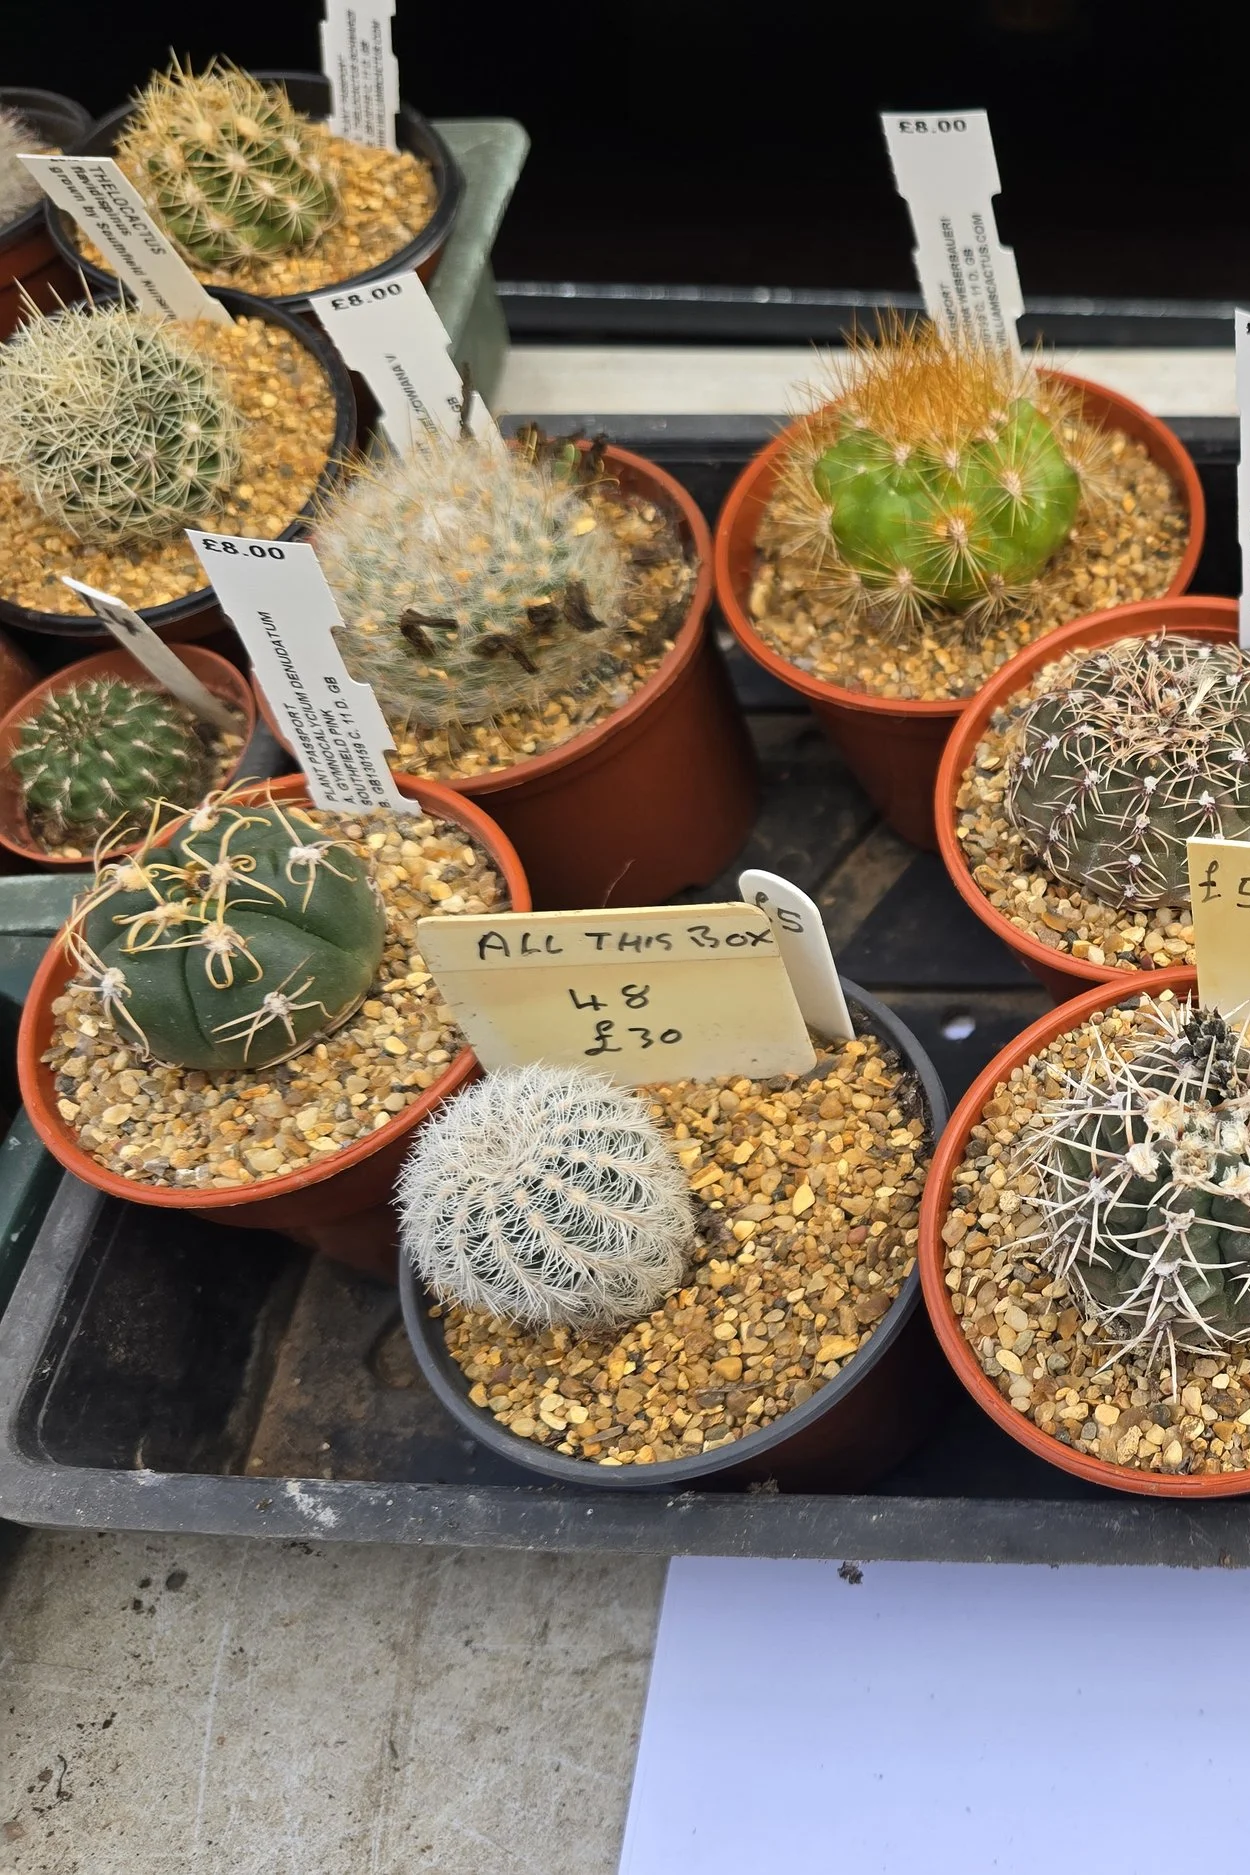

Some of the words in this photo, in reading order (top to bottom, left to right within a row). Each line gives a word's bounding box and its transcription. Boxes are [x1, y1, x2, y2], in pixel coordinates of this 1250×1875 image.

[899, 120, 966, 133] £8.00
[71, 166, 132, 237] flavidispinus
[89, 166, 166, 256] THELOCACTUS
[49, 167, 85, 202] grown
[83, 205, 99, 220] by
[97, 222, 147, 277] Southfield
[331, 283, 403, 311] £8.00
[202, 538, 285, 560] £8.00
[258, 611, 304, 690] DENUDATUM
[324, 676, 341, 694] GB
[335, 698, 350, 710] D.
[283, 702, 320, 765] PASSPORT
[320, 709, 341, 736] PINK
[343, 713, 356, 726] 11
[348, 729, 361, 740] C.
[298, 691, 349, 791] GYMNOCALYCIUM
[334, 737, 373, 806] SOUTHFIELD
[355, 741, 385, 795] GB130159
[314, 769, 338, 802] PLANT
[344, 795, 355, 805] A.
[378, 798, 392, 808] B.
[477, 930, 564, 961] ALL
[585, 931, 673, 953] THIS
[687, 924, 776, 948] BOX
[568, 984, 650, 1011] 48
[584, 1020, 683, 1056] £30
